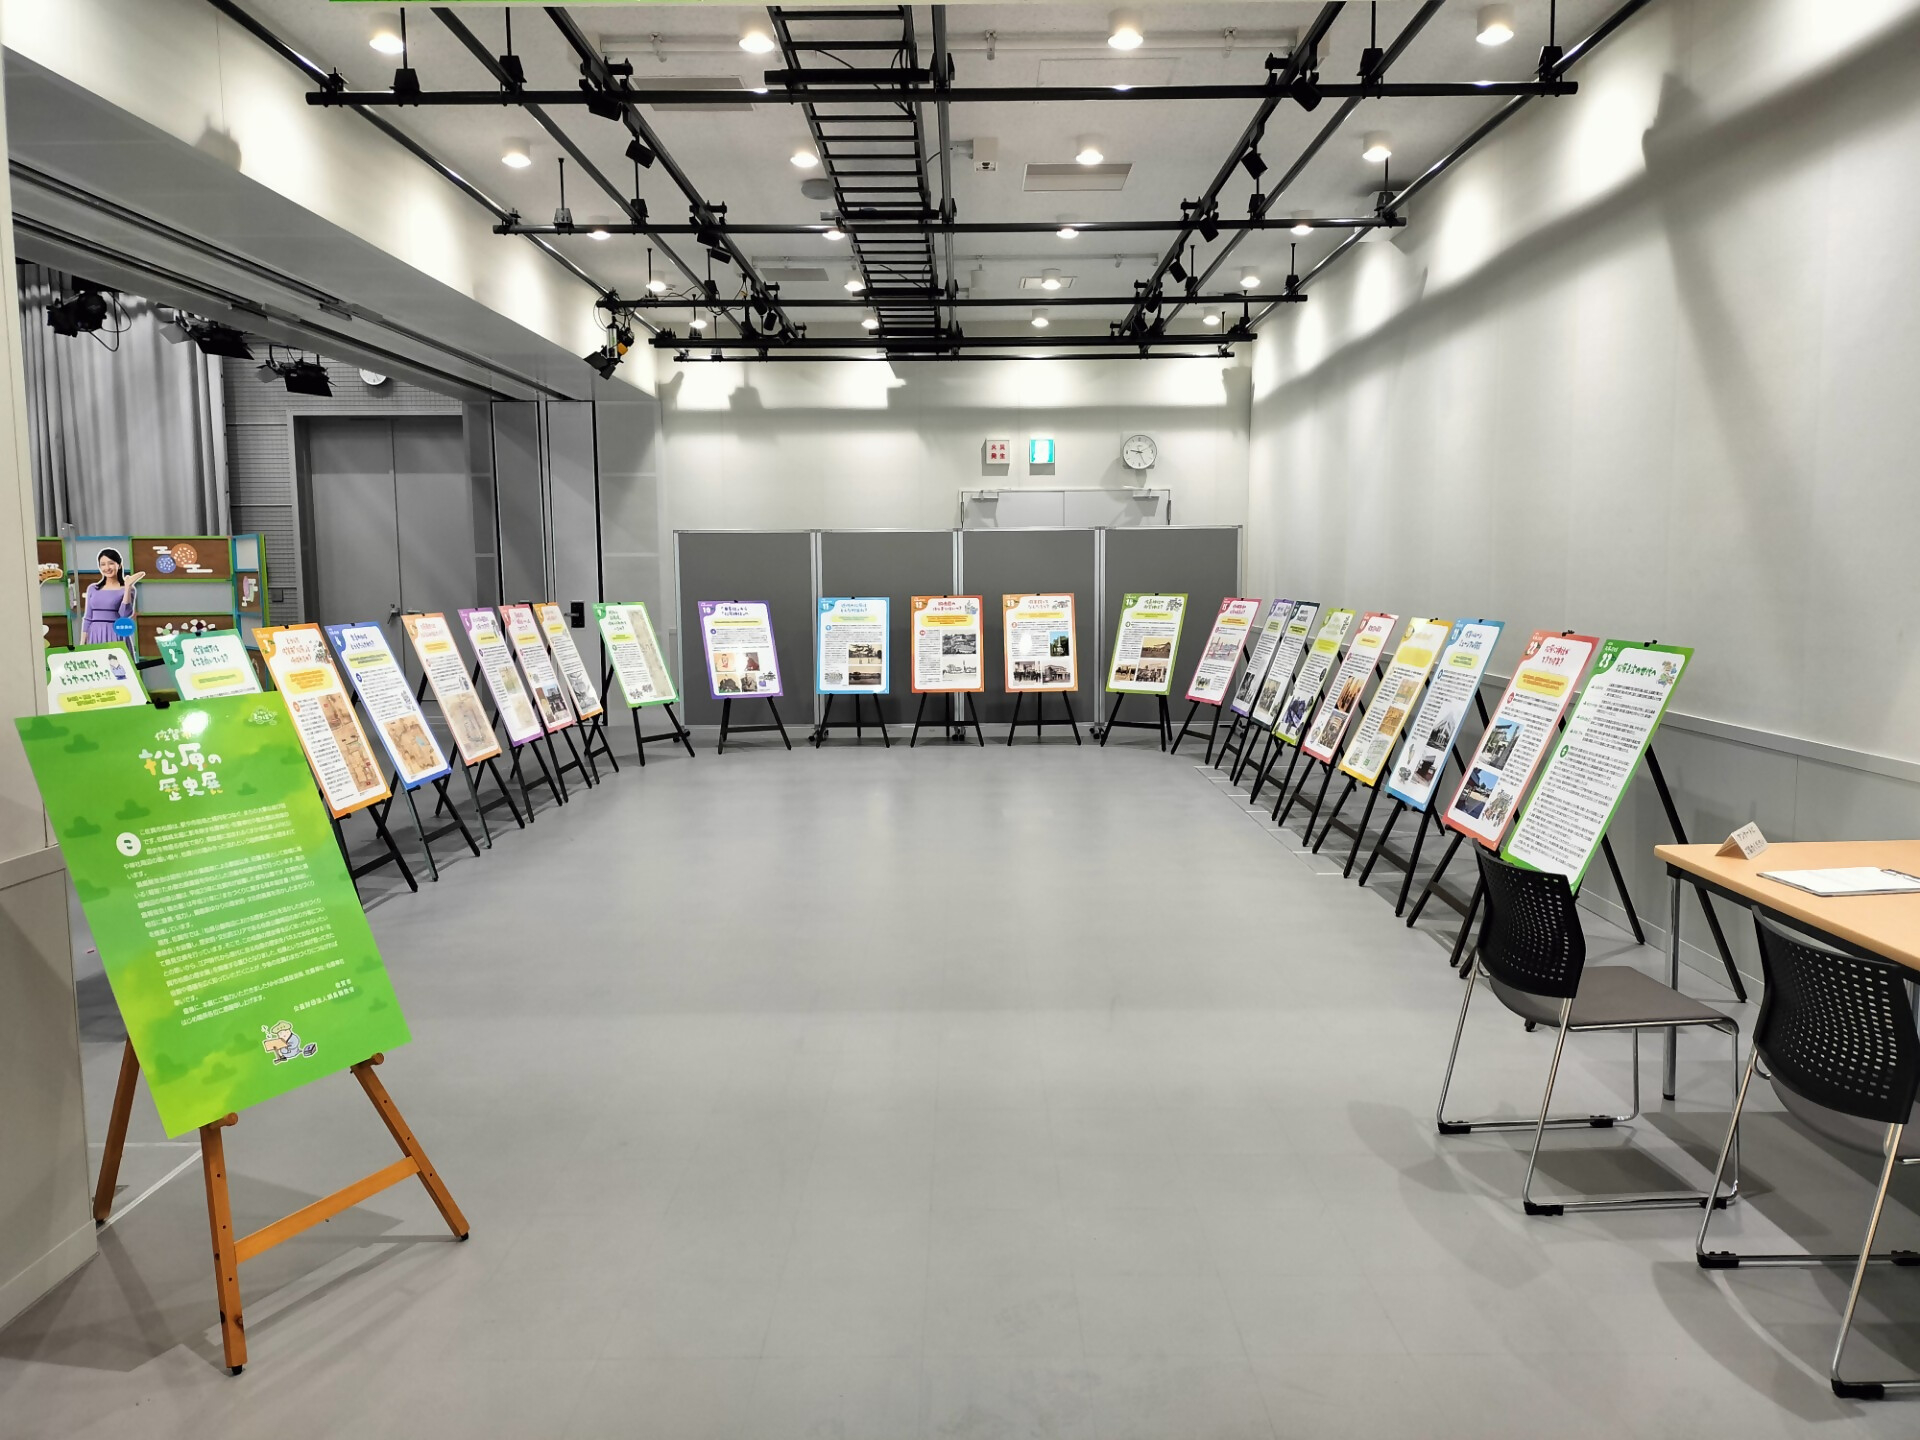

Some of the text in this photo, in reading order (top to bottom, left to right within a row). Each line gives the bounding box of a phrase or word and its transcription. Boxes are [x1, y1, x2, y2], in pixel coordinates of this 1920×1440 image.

[64, 660, 99, 671] 佐賀城下は
[168, 648, 178, 663] 2
[138, 743, 222, 776] 松原の
[159, 771, 223, 801] 歴史展
